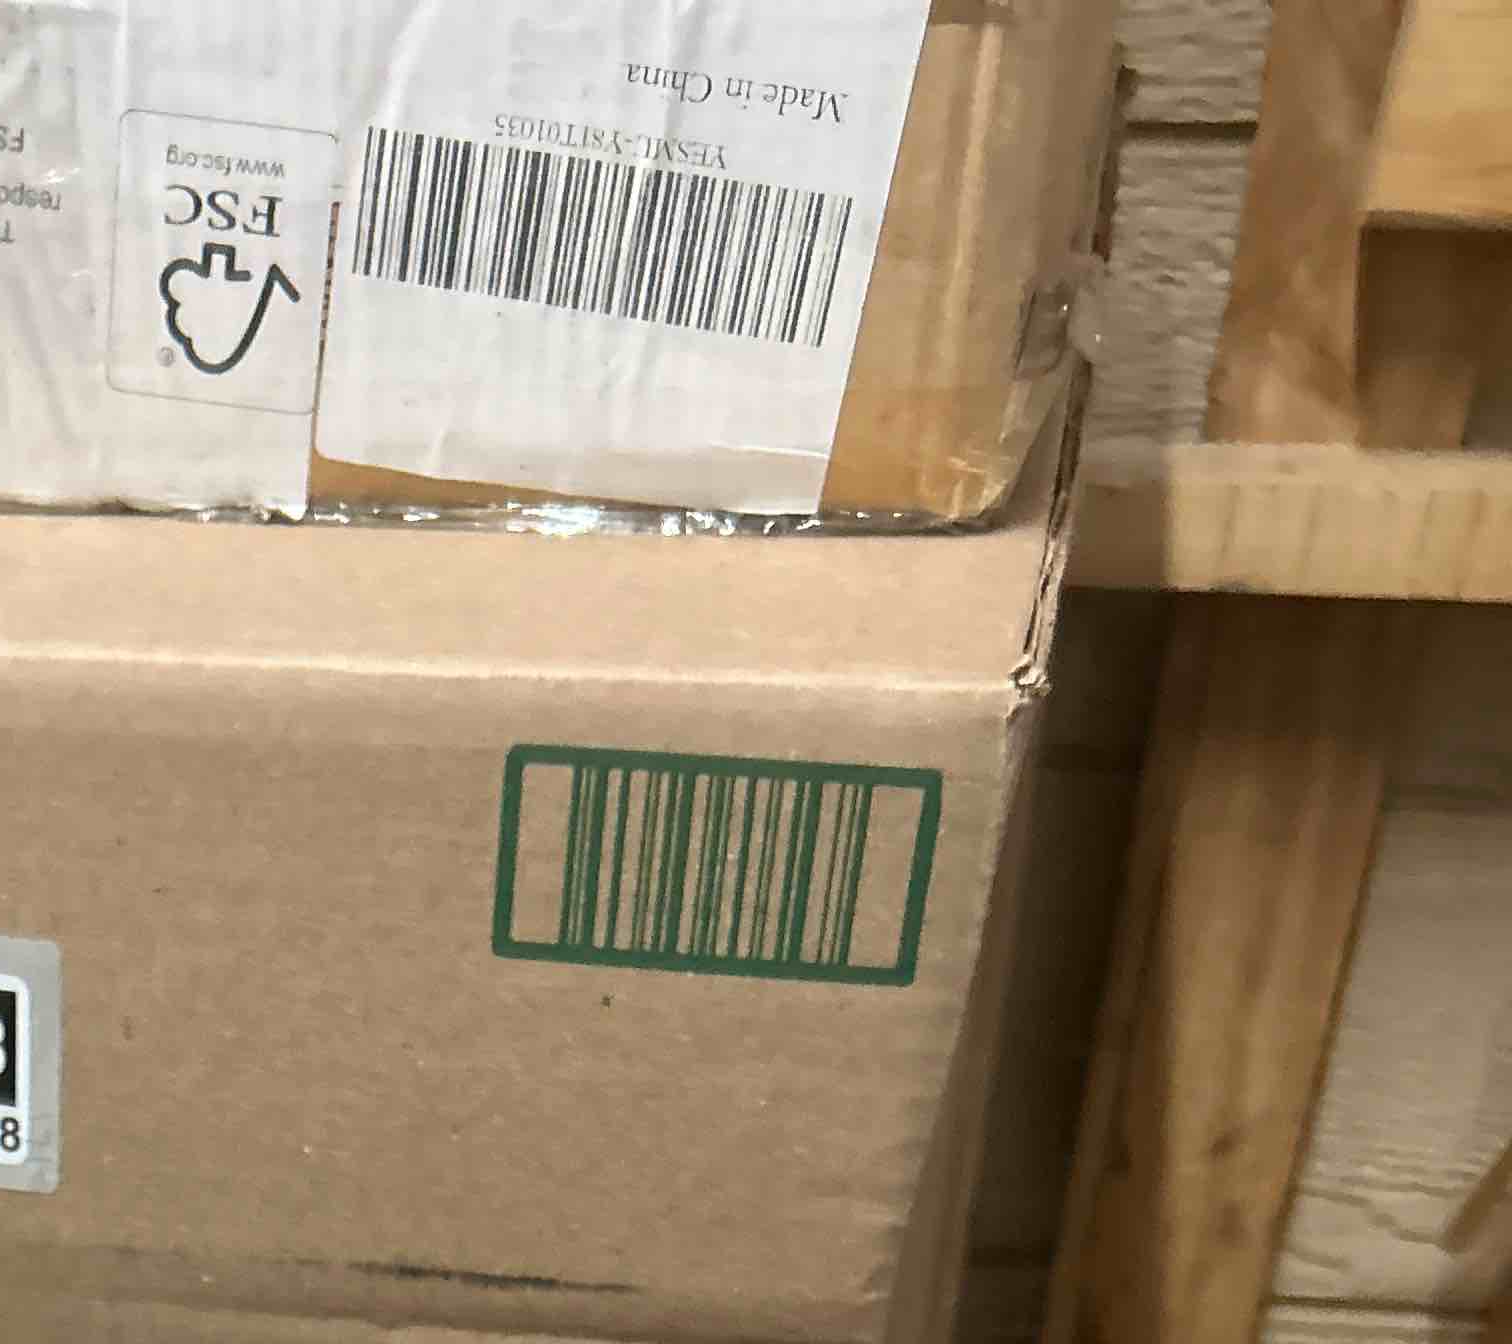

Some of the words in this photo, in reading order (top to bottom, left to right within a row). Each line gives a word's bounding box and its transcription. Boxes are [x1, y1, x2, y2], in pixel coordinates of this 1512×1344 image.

[625, 62, 712, 103] China
[726, 77, 753, 112] in
[765, 81, 848, 124] Made
[166, 143, 285, 180] www.fsc.org
[164, 184, 284, 238] FSC
